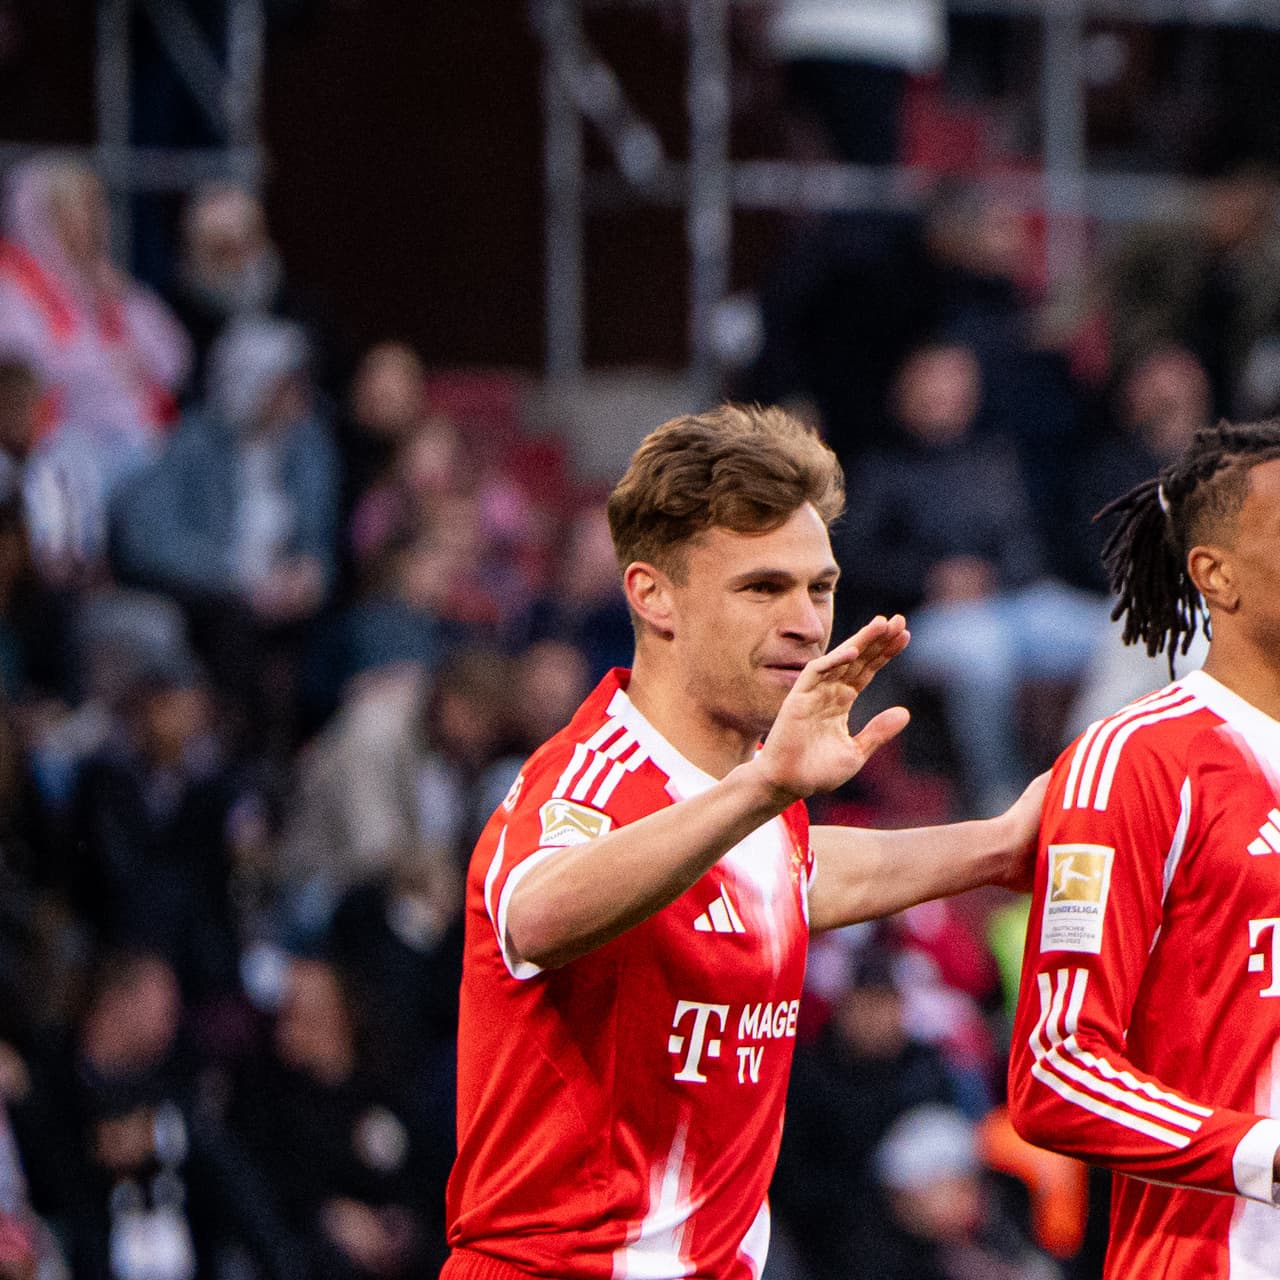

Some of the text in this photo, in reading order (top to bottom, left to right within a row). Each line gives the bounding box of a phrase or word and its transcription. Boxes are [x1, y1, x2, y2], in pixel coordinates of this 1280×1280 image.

[737, 999, 800, 1040] MAGE
[668, 999, 730, 1083] T
[736, 1045, 765, 1085] TV
